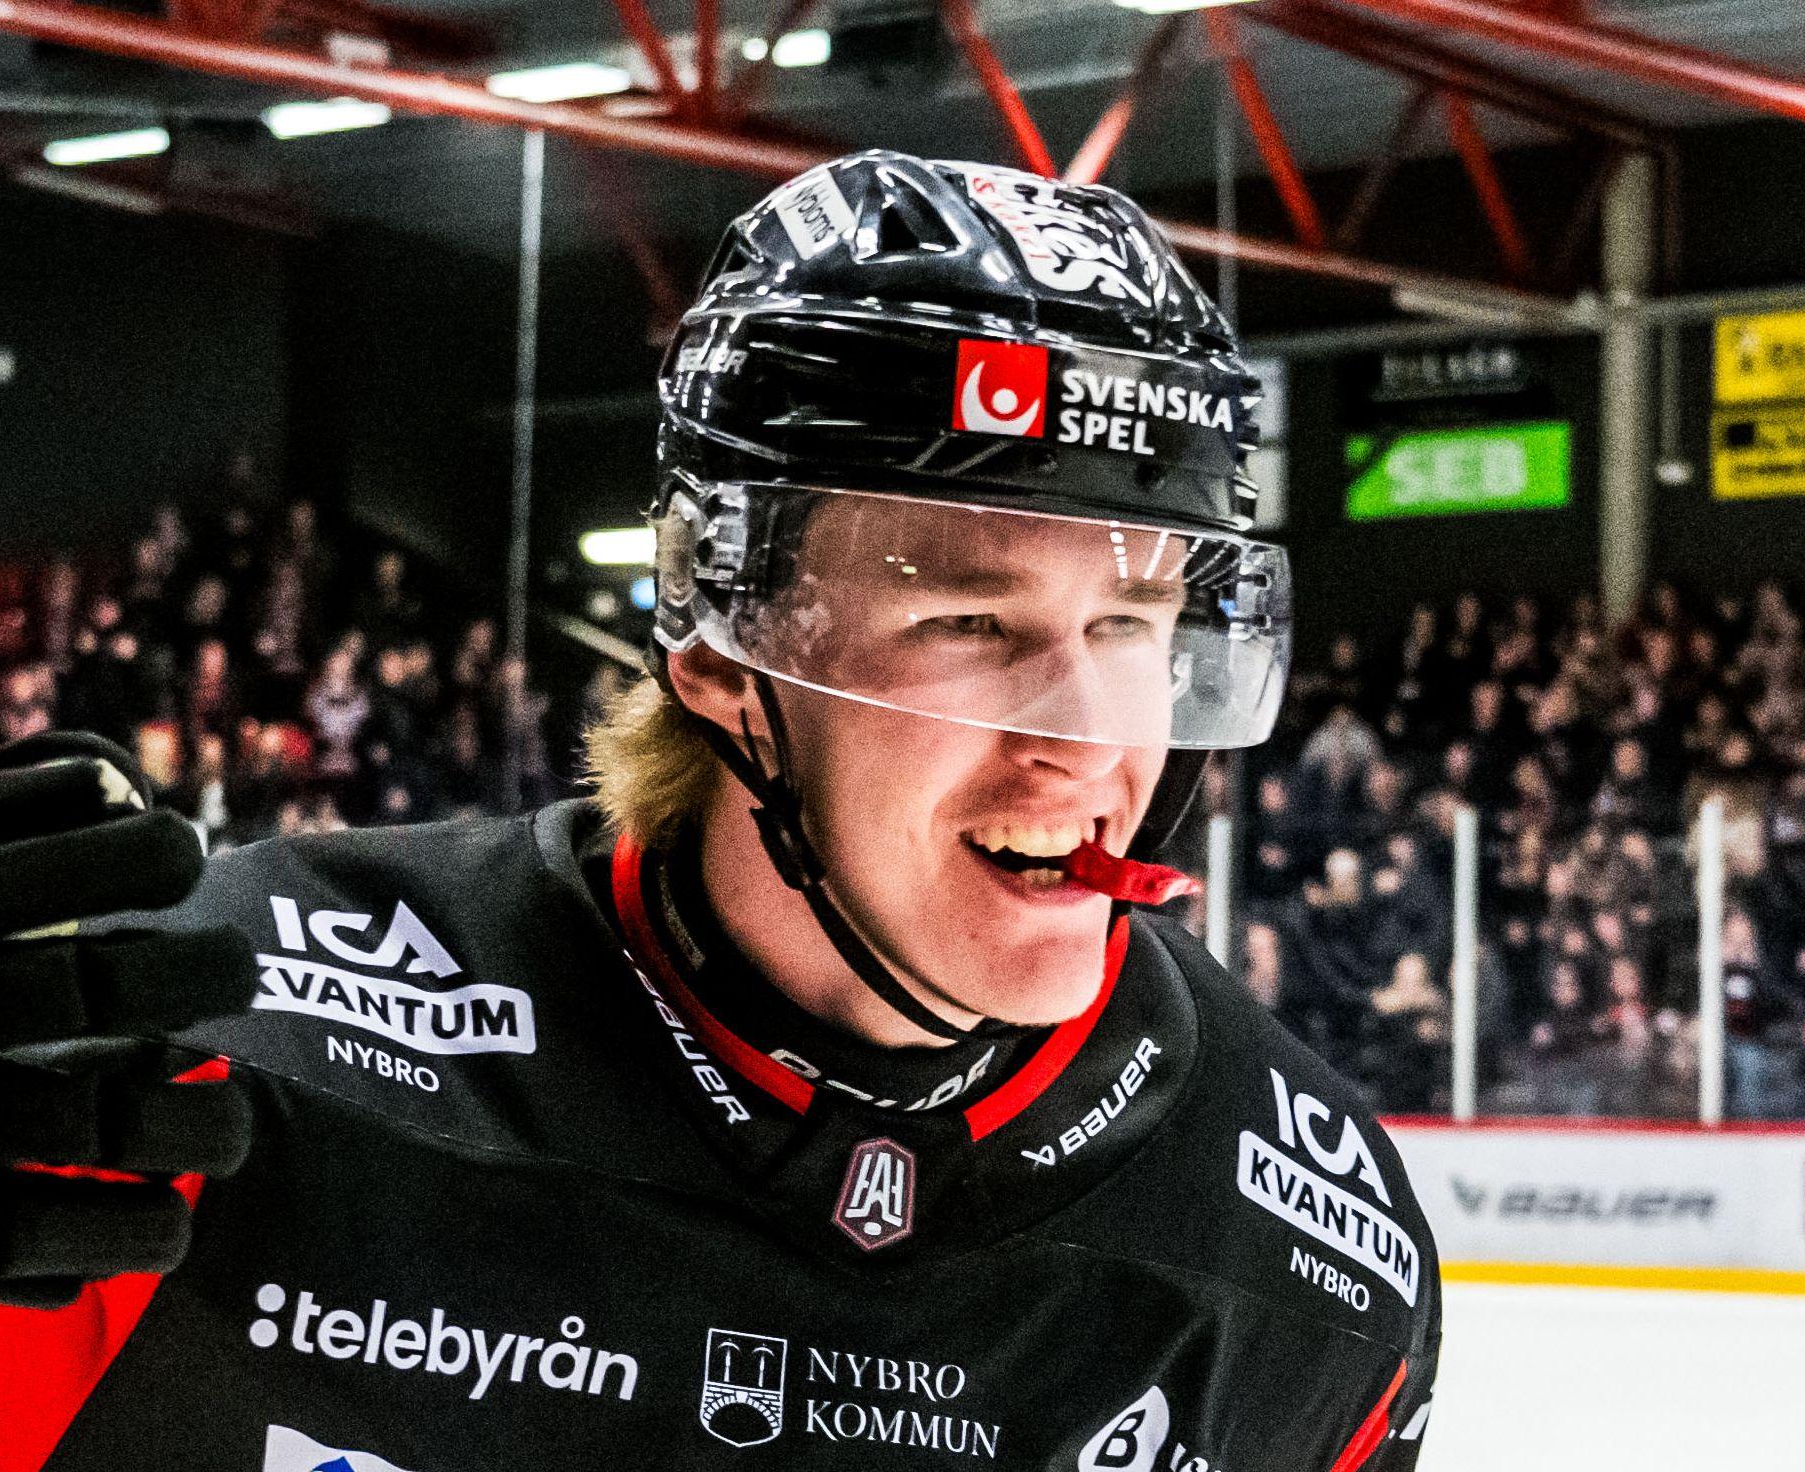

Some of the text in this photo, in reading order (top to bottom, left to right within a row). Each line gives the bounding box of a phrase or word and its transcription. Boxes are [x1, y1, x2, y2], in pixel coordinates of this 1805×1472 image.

[1057, 407, 1155, 456] SPEL
[1061, 368, 1233, 432] SVENSKA
[1386, 438, 1524, 504] SEB
[269, 896, 463, 978] ICA
[327, 1035, 439, 1092] NYBRO
[1058, 1037, 1161, 1156] BAUER
[1269, 1067, 1393, 1208] ICA
[1250, 1147, 1414, 1289] KVANTUM
[1289, 1247, 1370, 1312] NYBRO
[292, 1290, 639, 1400] telebyrån
[806, 1347, 965, 1402] NYBRO
[805, 1399, 1001, 1459] KOMMUN
